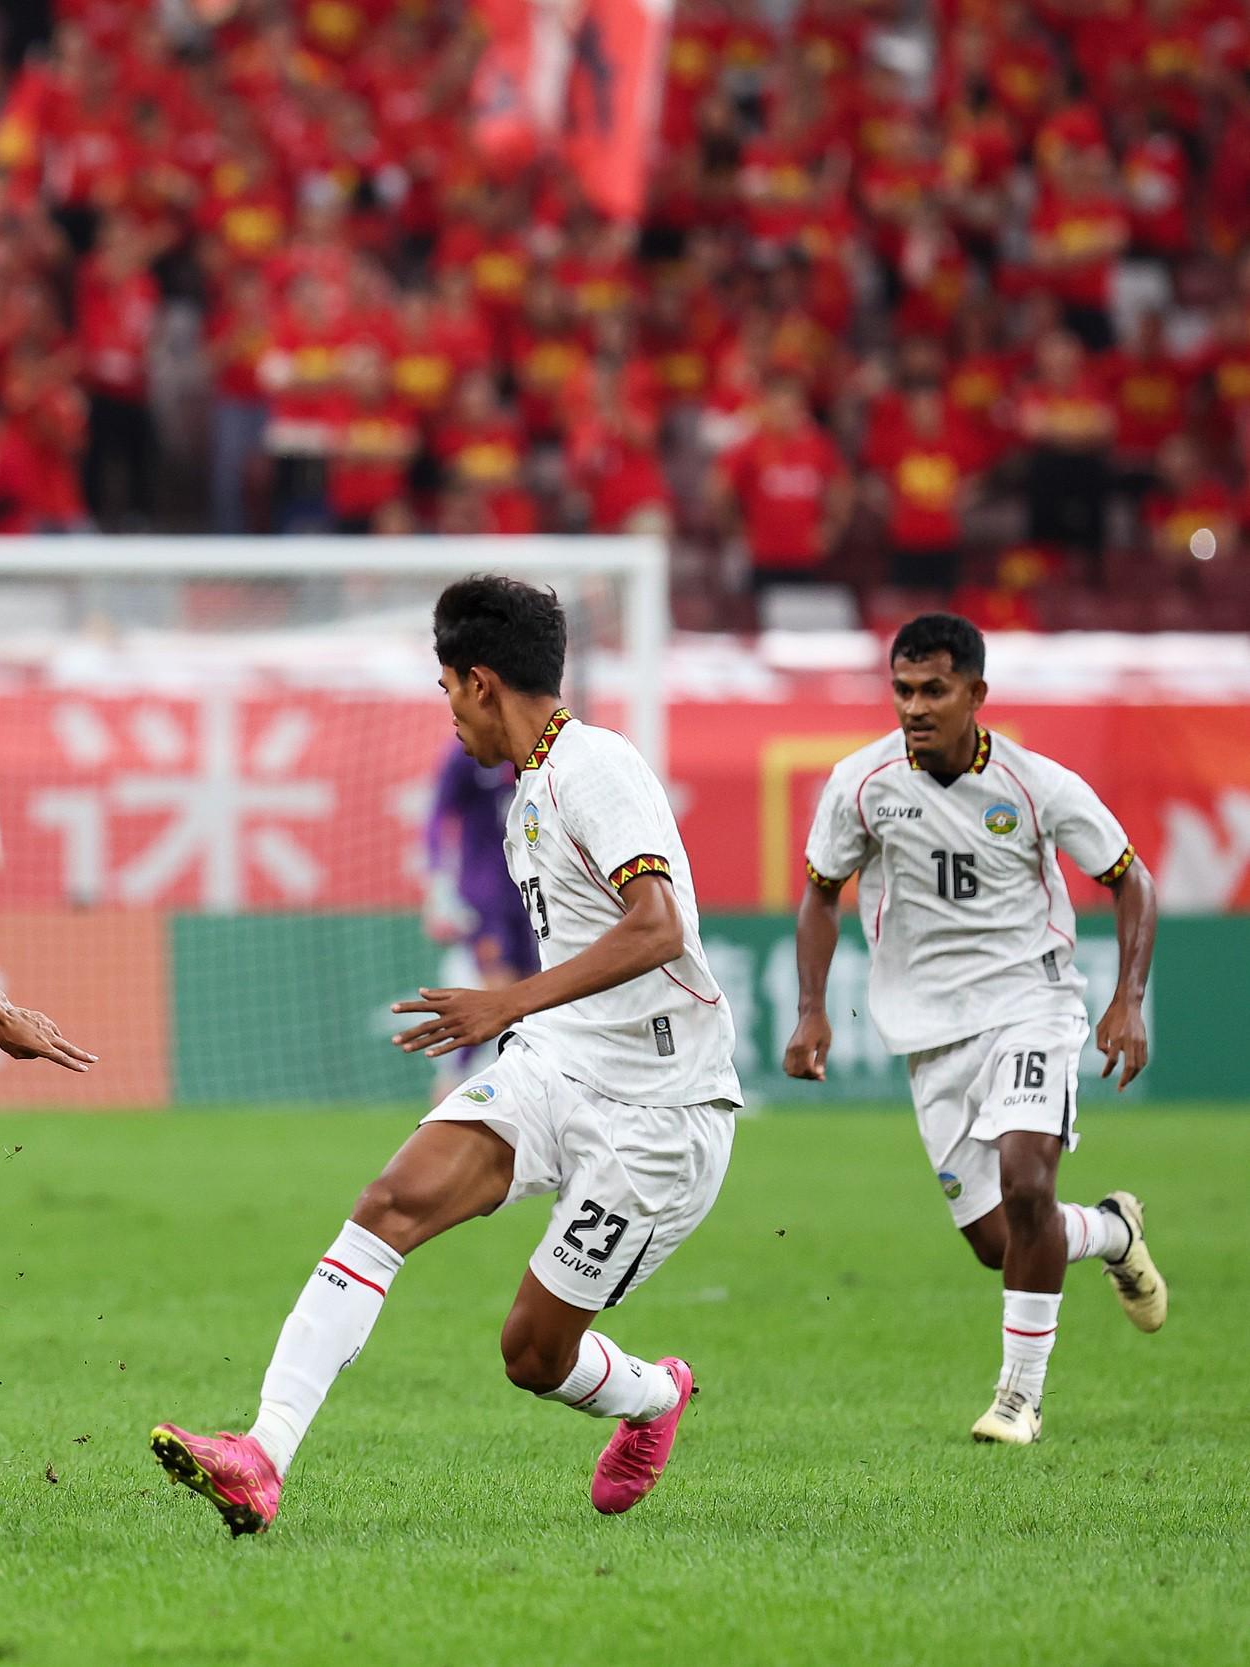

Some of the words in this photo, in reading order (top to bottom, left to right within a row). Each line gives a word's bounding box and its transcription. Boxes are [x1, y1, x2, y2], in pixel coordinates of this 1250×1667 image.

[930, 850, 978, 900] 16
[1013, 1050, 1047, 1090] 16
[562, 1199, 629, 1264] 23
